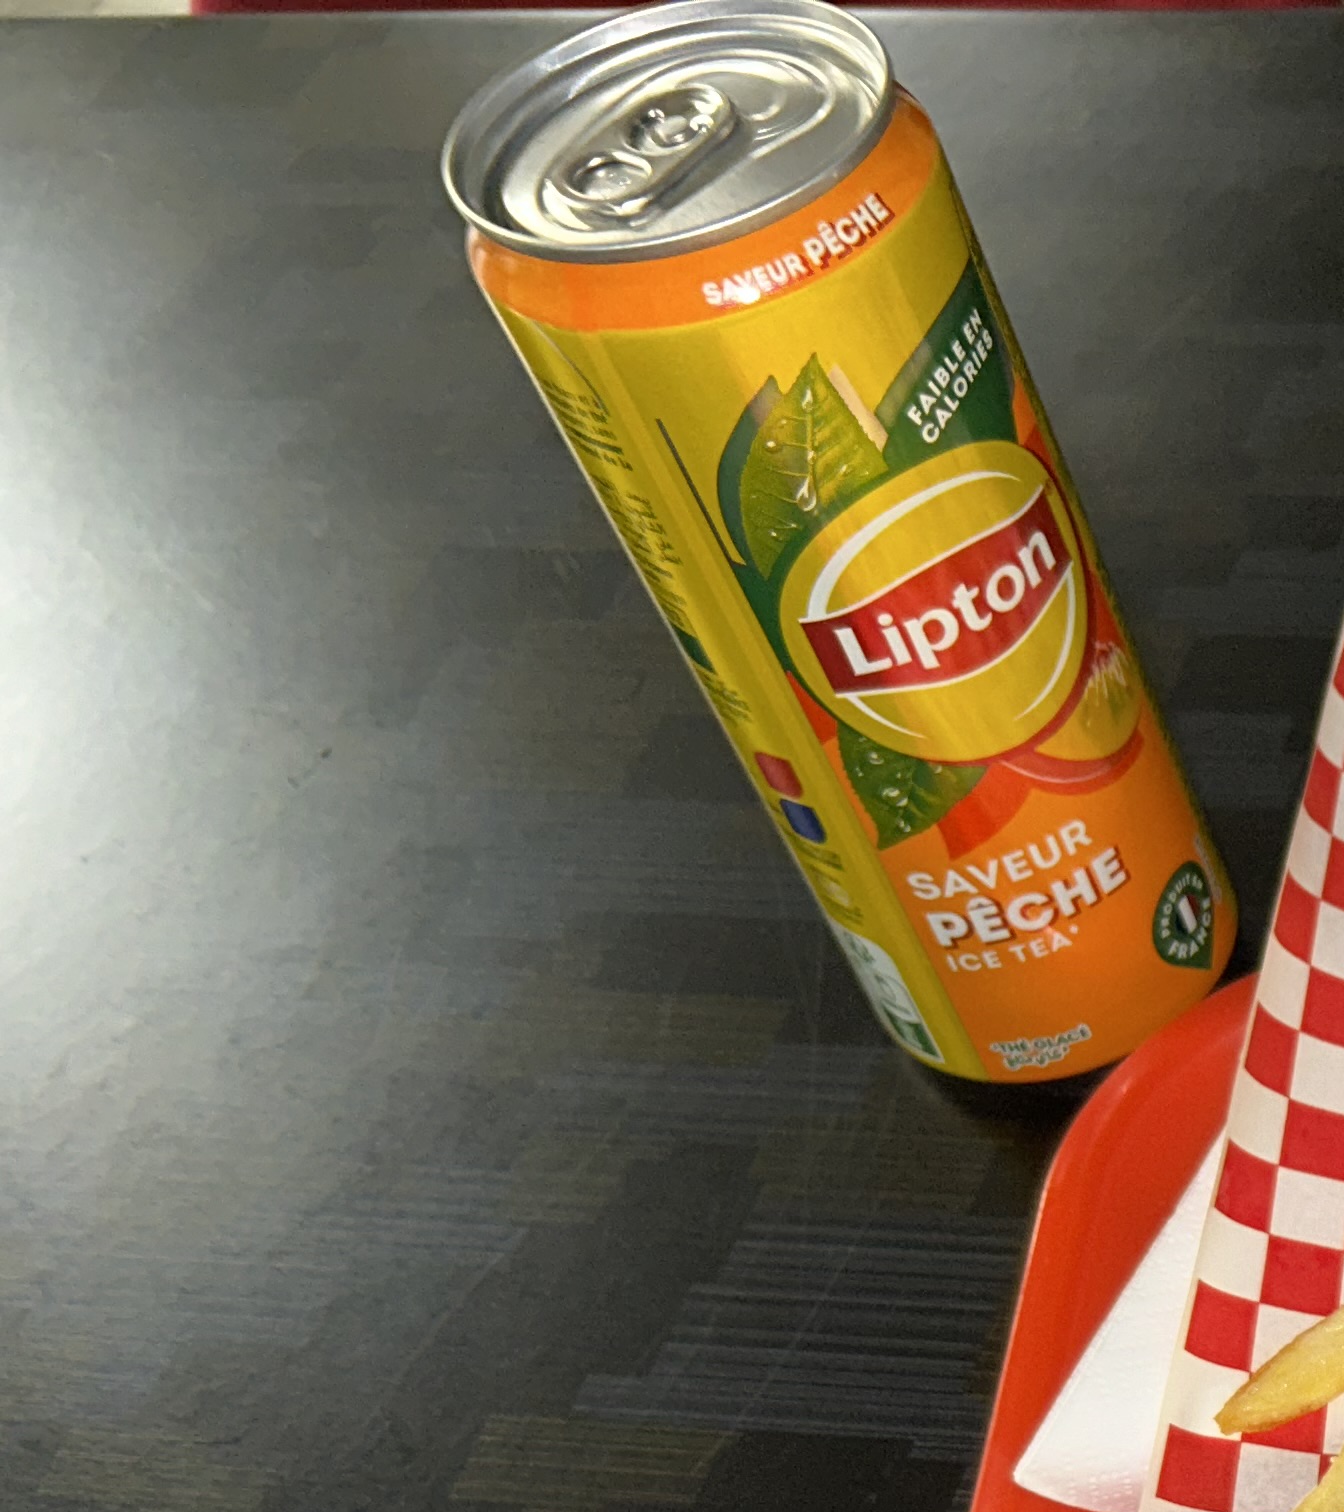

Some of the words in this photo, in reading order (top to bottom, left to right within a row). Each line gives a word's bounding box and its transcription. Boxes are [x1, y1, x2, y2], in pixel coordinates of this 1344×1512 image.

[702, 253, 812, 307] SAVEUR
[803, 192, 894, 268] PÊCHE
[907, 340, 966, 426] FAIBLE
[963, 308, 983, 346] EN
[922, 329, 994, 444] CALORIES
[833, 531, 1056, 677] Lipton
[907, 819, 1093, 901] SAVEUR
[926, 846, 1129, 949] PÊCHE
[946, 950, 1003, 973] ICE
